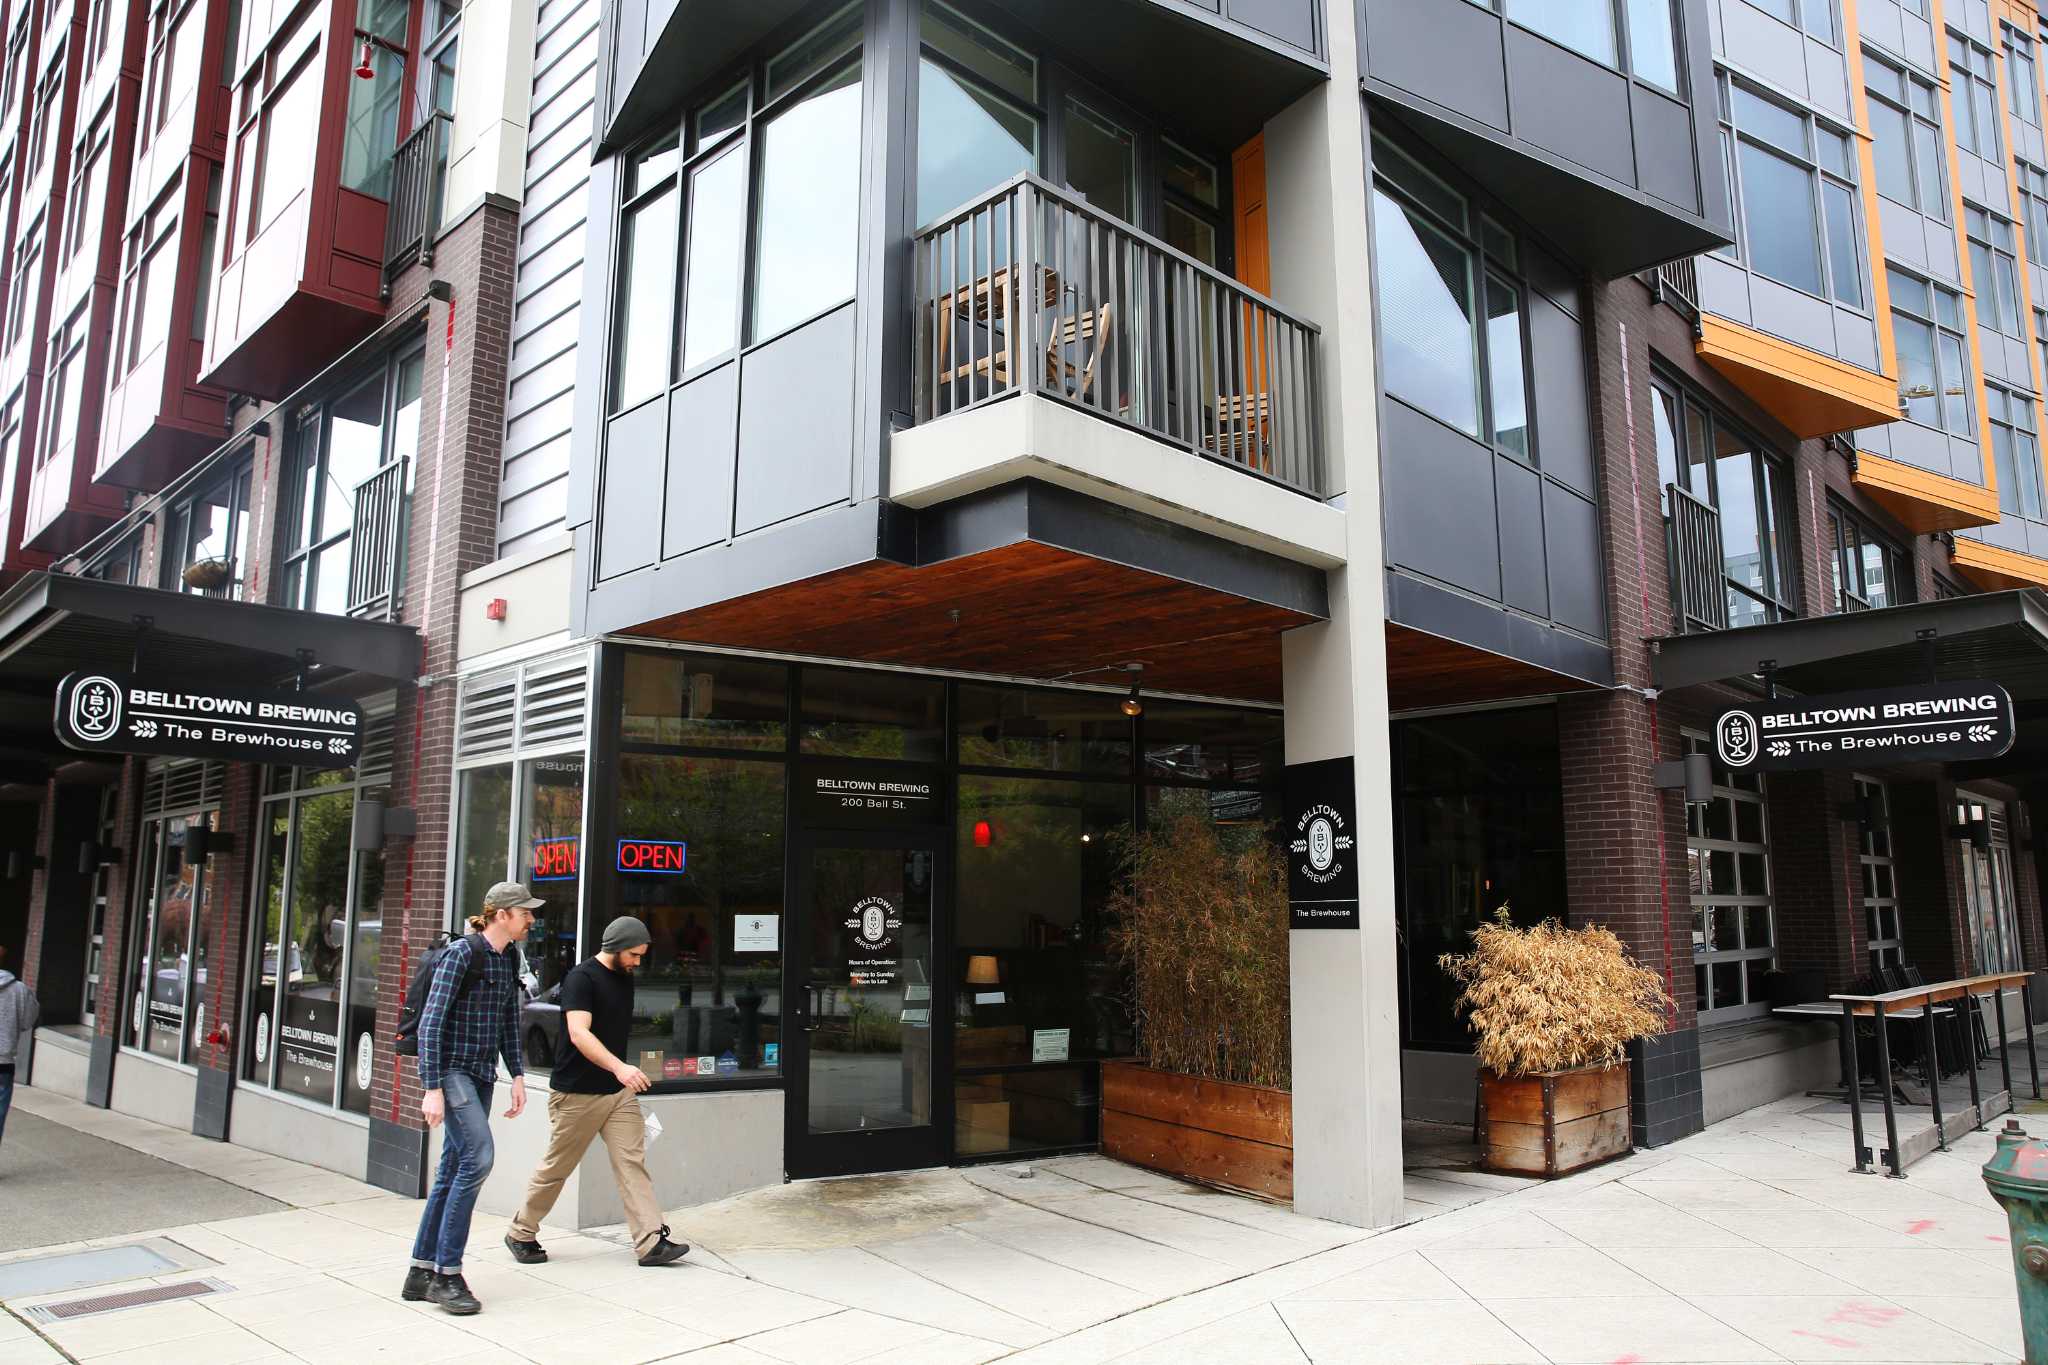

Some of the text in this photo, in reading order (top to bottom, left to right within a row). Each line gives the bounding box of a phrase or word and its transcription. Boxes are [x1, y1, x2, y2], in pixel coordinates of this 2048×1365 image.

[129, 688, 357, 726] BELLTOWN BREWING
[1762, 694, 1998, 729] BELLTOWN BREWING
[163, 723, 323, 750] The Brewhouse
[1796, 730, 1962, 753] The Brewhouse
[816, 778, 930, 794] BELLTOWN BREWING
[841, 797, 907, 809] 200 Bell St.
[1297, 804, 1345, 832] BELLTOWN
[534, 842, 577, 876] OPEN
[620, 844, 683, 870] OPEN
[1301, 863, 1343, 884] BREWING
[852, 896, 896, 915] BELLTOWN
[1296, 908, 1351, 917] The Brewhouse
[854, 936, 892, 950] BREWING
[281, 1025, 338, 1047] BELLTOWN BREWIN
[286, 1049, 334, 1072] The Brewhouse
